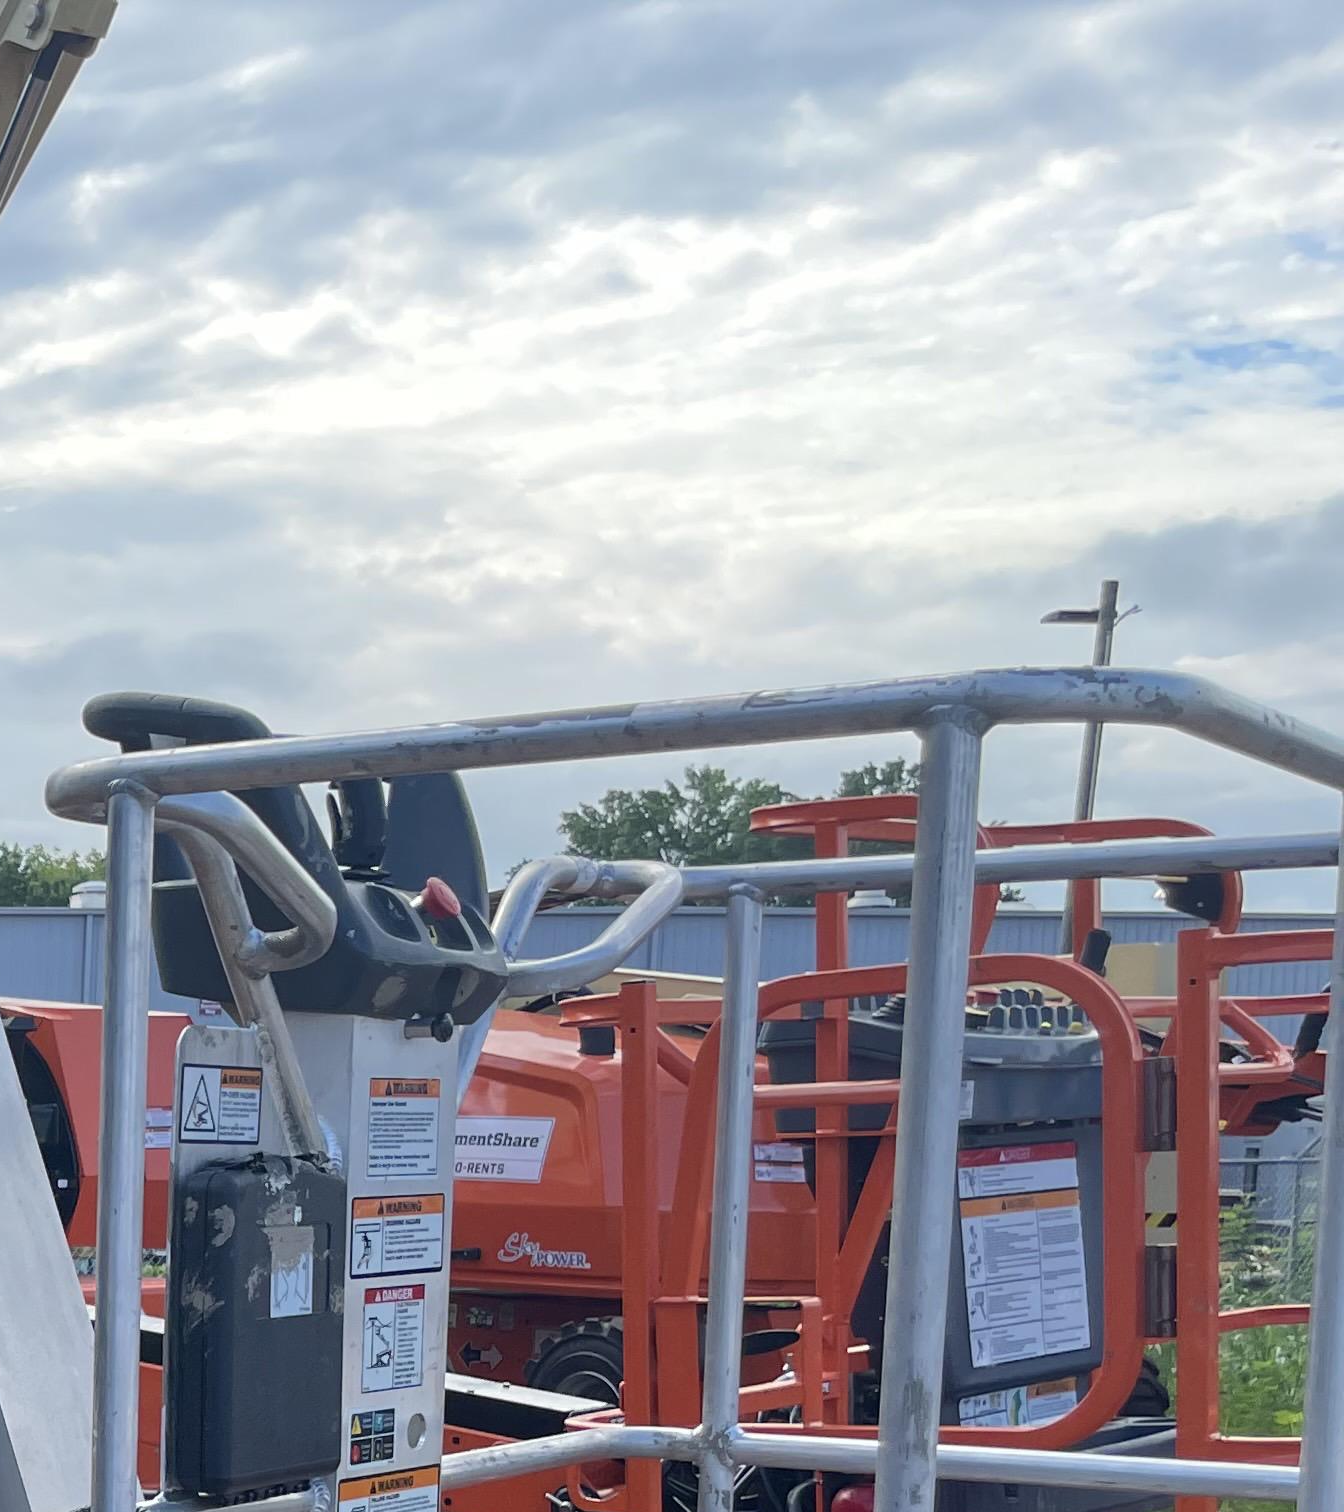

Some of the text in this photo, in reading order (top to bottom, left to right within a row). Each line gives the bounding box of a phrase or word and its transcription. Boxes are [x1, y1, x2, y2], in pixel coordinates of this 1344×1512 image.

[393, 1083, 428, 1094] WARNING
[386, 1200, 422, 1214] WARNING
[383, 1288, 413, 1302] DANGER
[377, 1476, 414, 1492] WARNING
